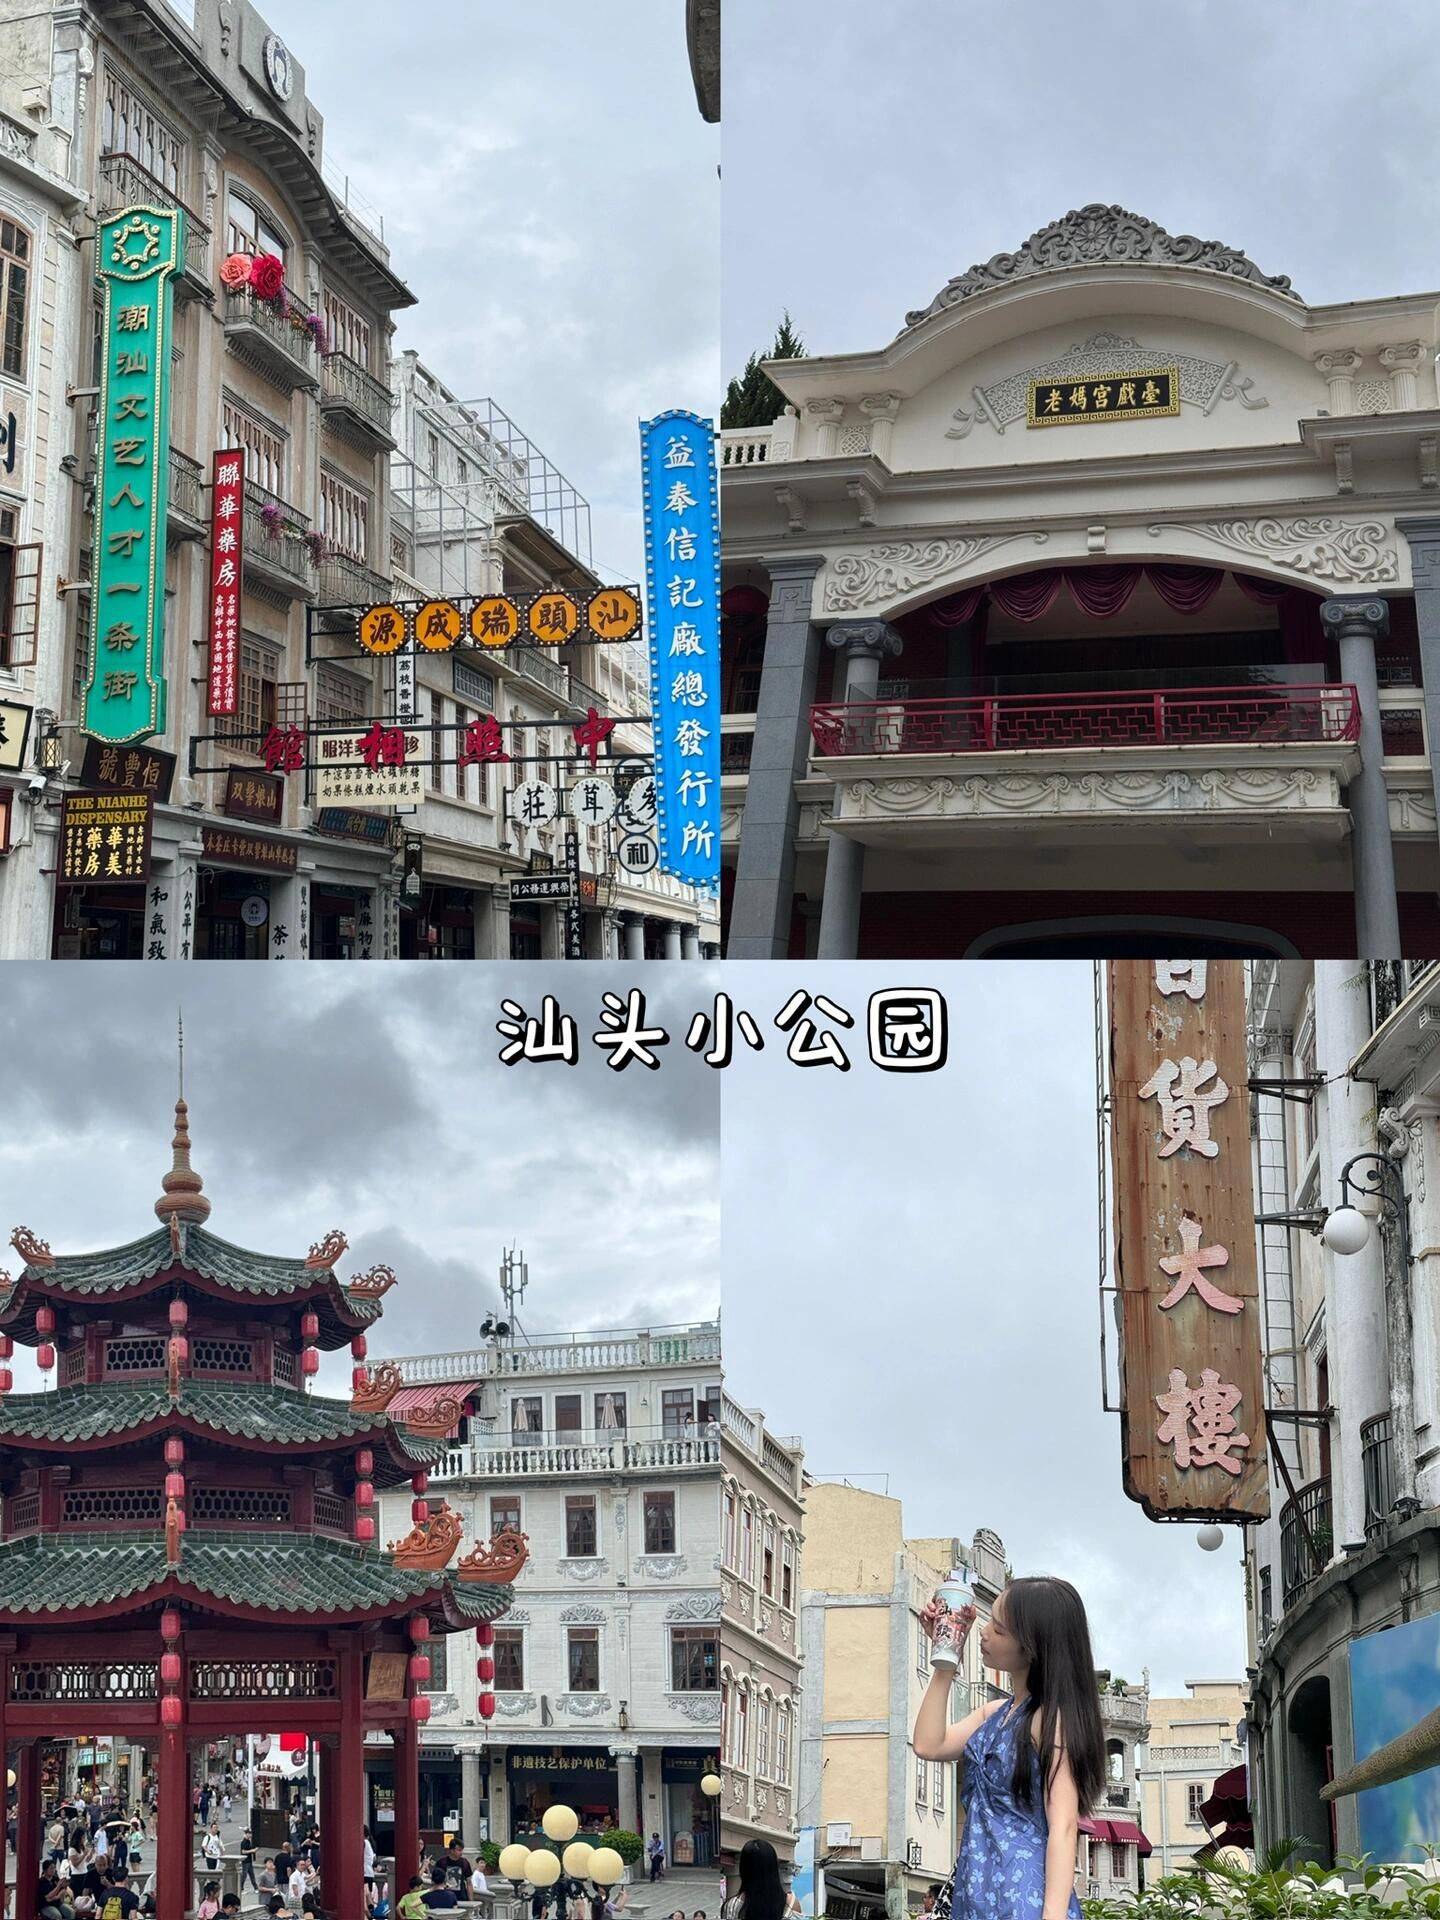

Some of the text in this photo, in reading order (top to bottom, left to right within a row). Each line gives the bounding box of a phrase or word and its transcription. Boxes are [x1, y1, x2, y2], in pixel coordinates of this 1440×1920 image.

[214, 461, 240, 587] 聯華藥房
[662, 434, 714, 859] 益奉信記廠總發行所
[65, 810, 148, 825] DISPENSARY
[67, 795, 147, 810] THE NIANHE
[272, 925, 289, 960] 茶
